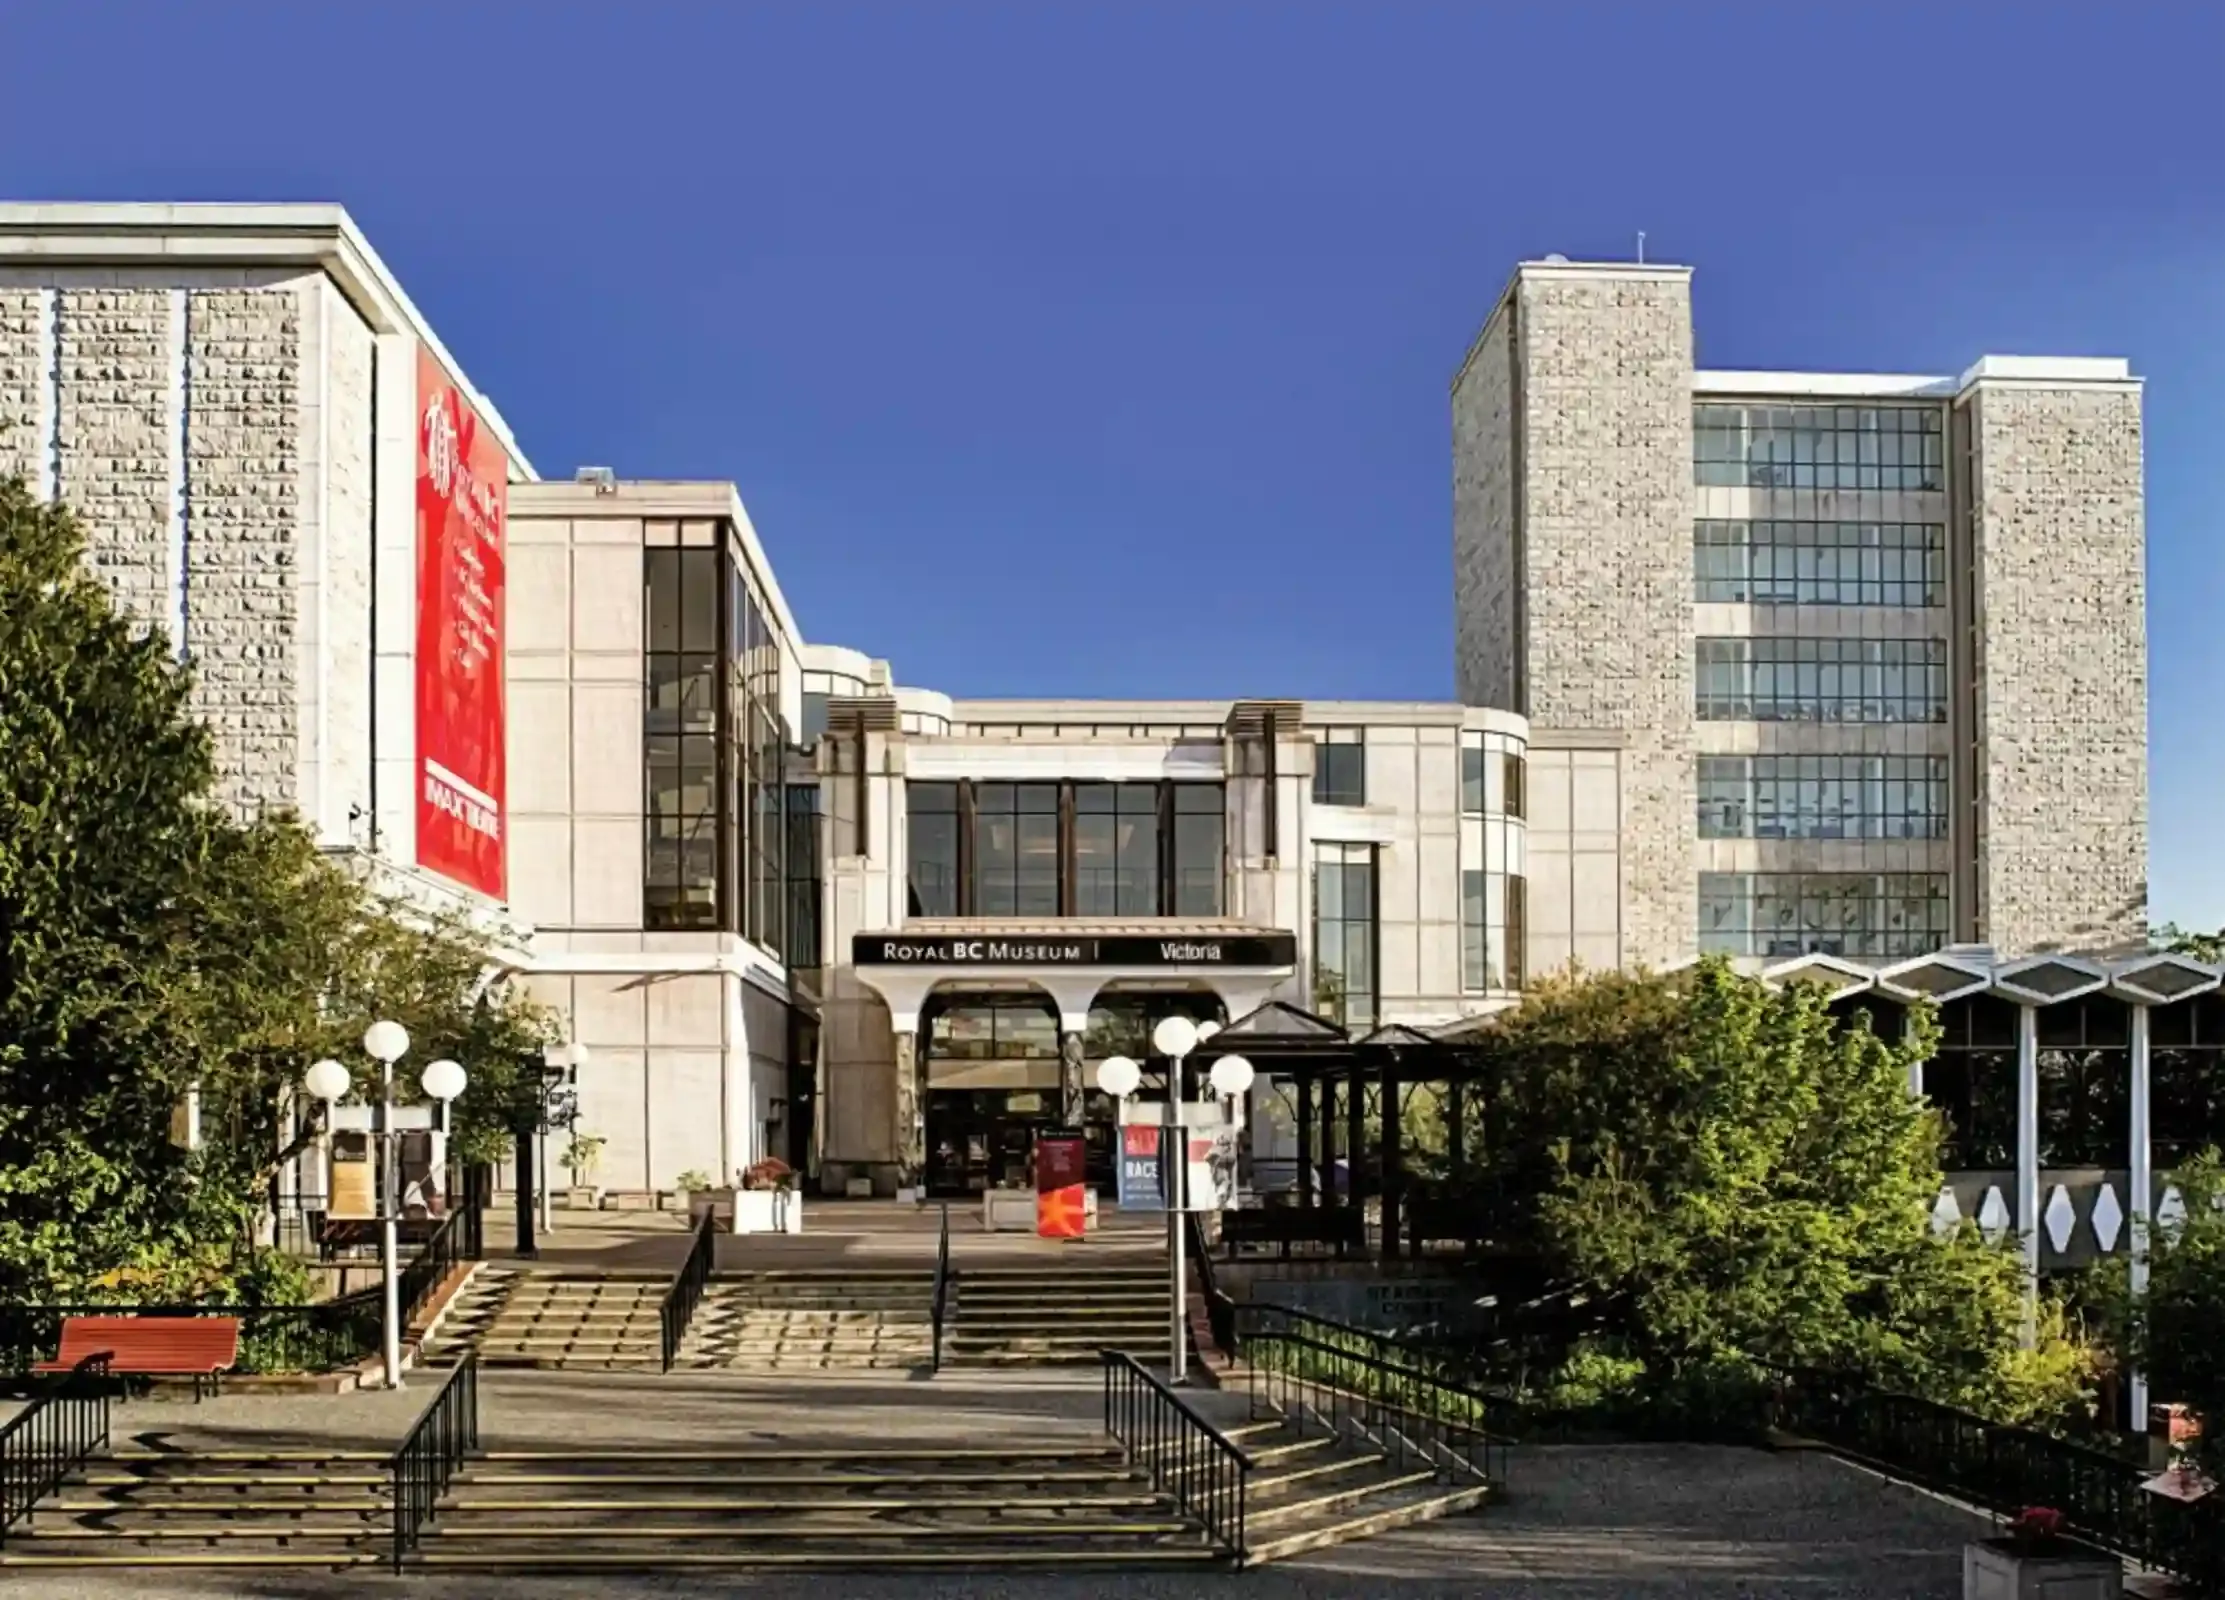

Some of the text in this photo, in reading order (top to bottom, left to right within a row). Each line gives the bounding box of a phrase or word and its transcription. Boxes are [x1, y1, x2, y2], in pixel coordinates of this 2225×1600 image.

[884, 942, 1221, 960] ROYAL BC MUSEUM Victoria
